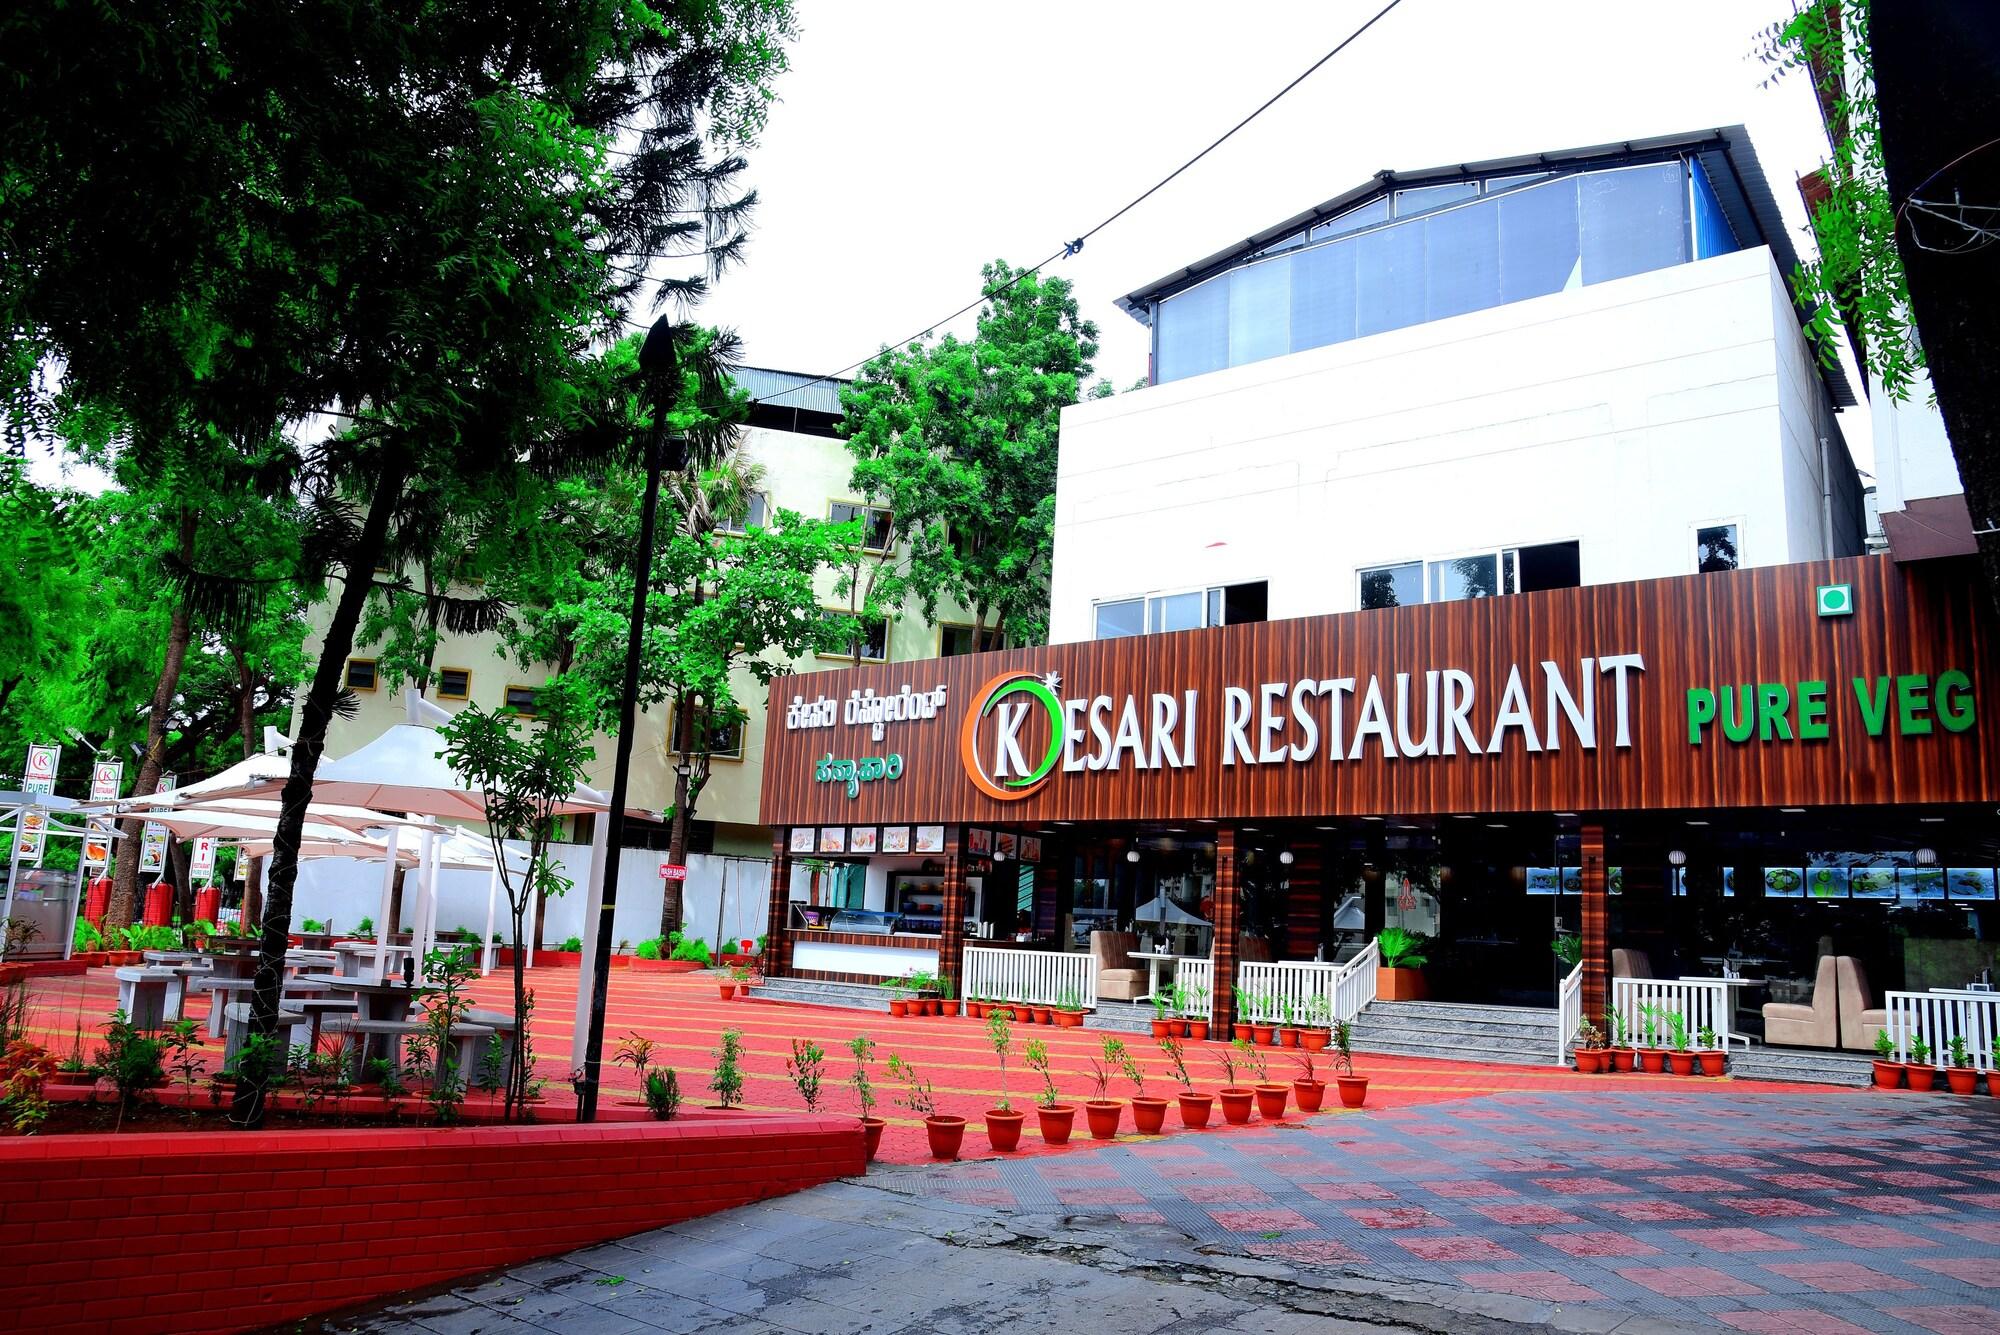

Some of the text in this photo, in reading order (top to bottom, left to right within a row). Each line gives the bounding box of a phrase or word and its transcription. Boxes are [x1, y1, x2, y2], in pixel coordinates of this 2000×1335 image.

[1222, 653, 1646, 765] RESTAURANT
[1687, 669, 1976, 744] PURE VEG
[27, 783, 49, 794] PURE
[815, 752, 903, 799] ಸಸ್ಯಾಹಾರಿ
